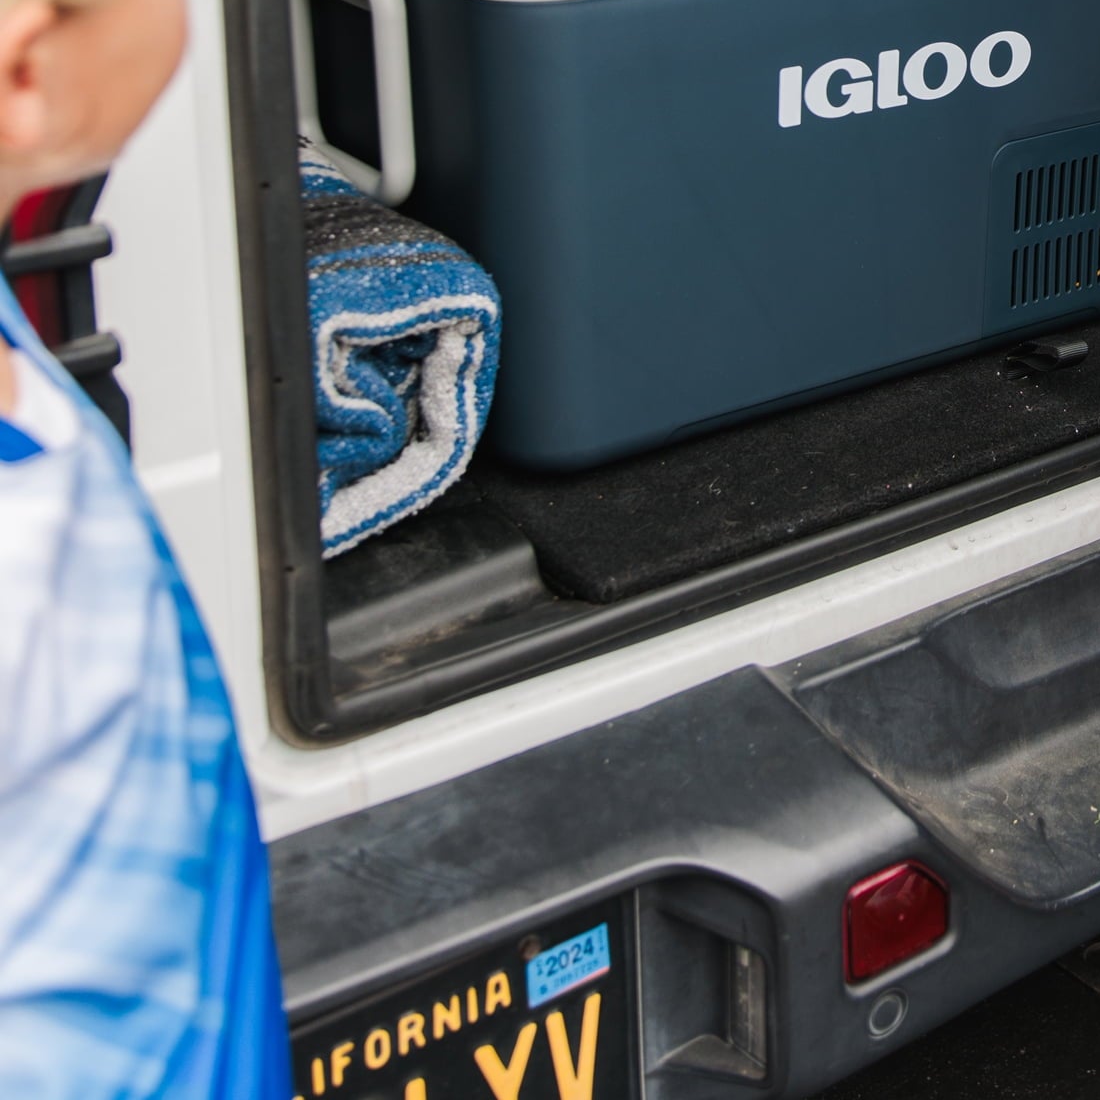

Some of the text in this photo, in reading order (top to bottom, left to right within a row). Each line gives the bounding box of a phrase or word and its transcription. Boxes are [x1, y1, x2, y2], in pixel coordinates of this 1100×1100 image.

[777, 30, 1032, 129] IGLOO
[545, 936, 595, 978] 2024
[291, 970, 513, 1100] IFORNIA
[404, 991, 602, 1100] YV
